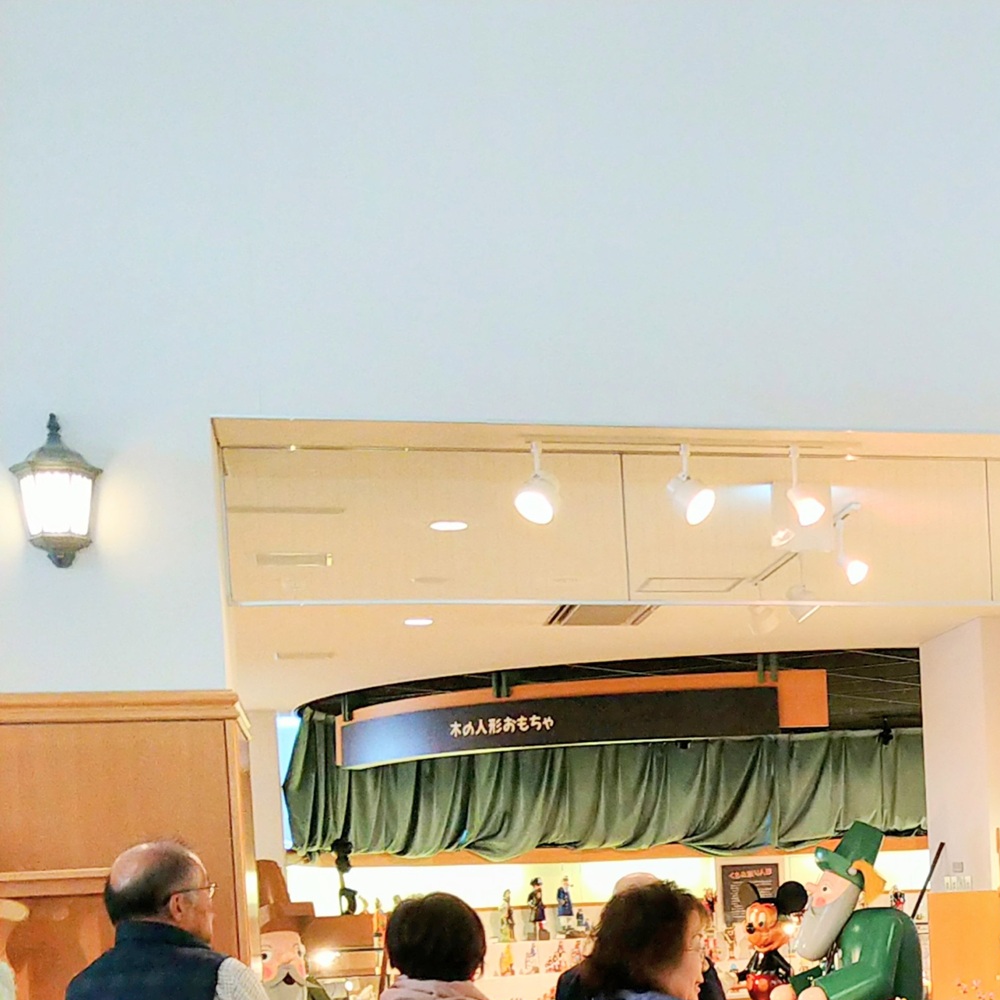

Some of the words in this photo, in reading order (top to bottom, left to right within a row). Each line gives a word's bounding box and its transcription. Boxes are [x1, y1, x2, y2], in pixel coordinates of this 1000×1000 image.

[449, 714, 555, 738] 木の人形おもちゃ
